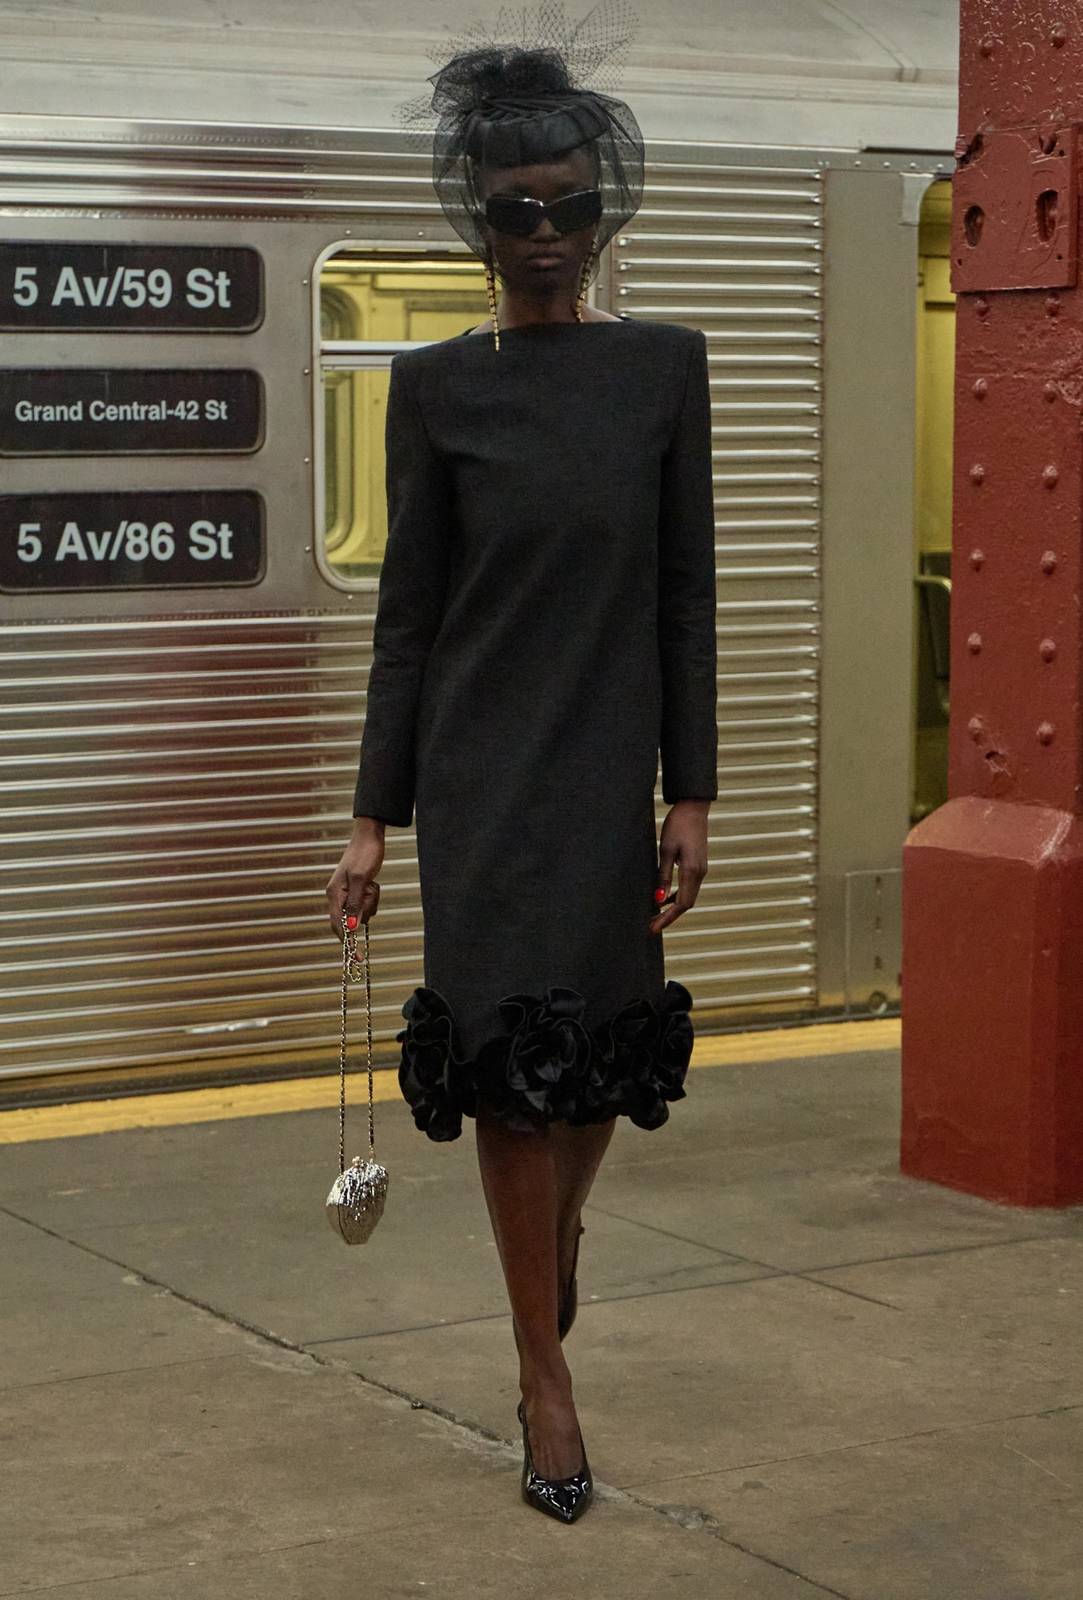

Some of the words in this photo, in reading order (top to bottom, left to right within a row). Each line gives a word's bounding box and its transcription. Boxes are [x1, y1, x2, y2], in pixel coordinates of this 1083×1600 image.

[13, 267, 38, 307] 5
[51, 266, 172, 308] Av/59
[186, 268, 231, 308] St
[15, 401, 83, 421] Grand
[89, 400, 199, 421] Central-42
[205, 400, 228, 420] St
[17, 523, 42, 562] 5
[55, 521, 175, 561] Av/86
[189, 521, 233, 560] St
